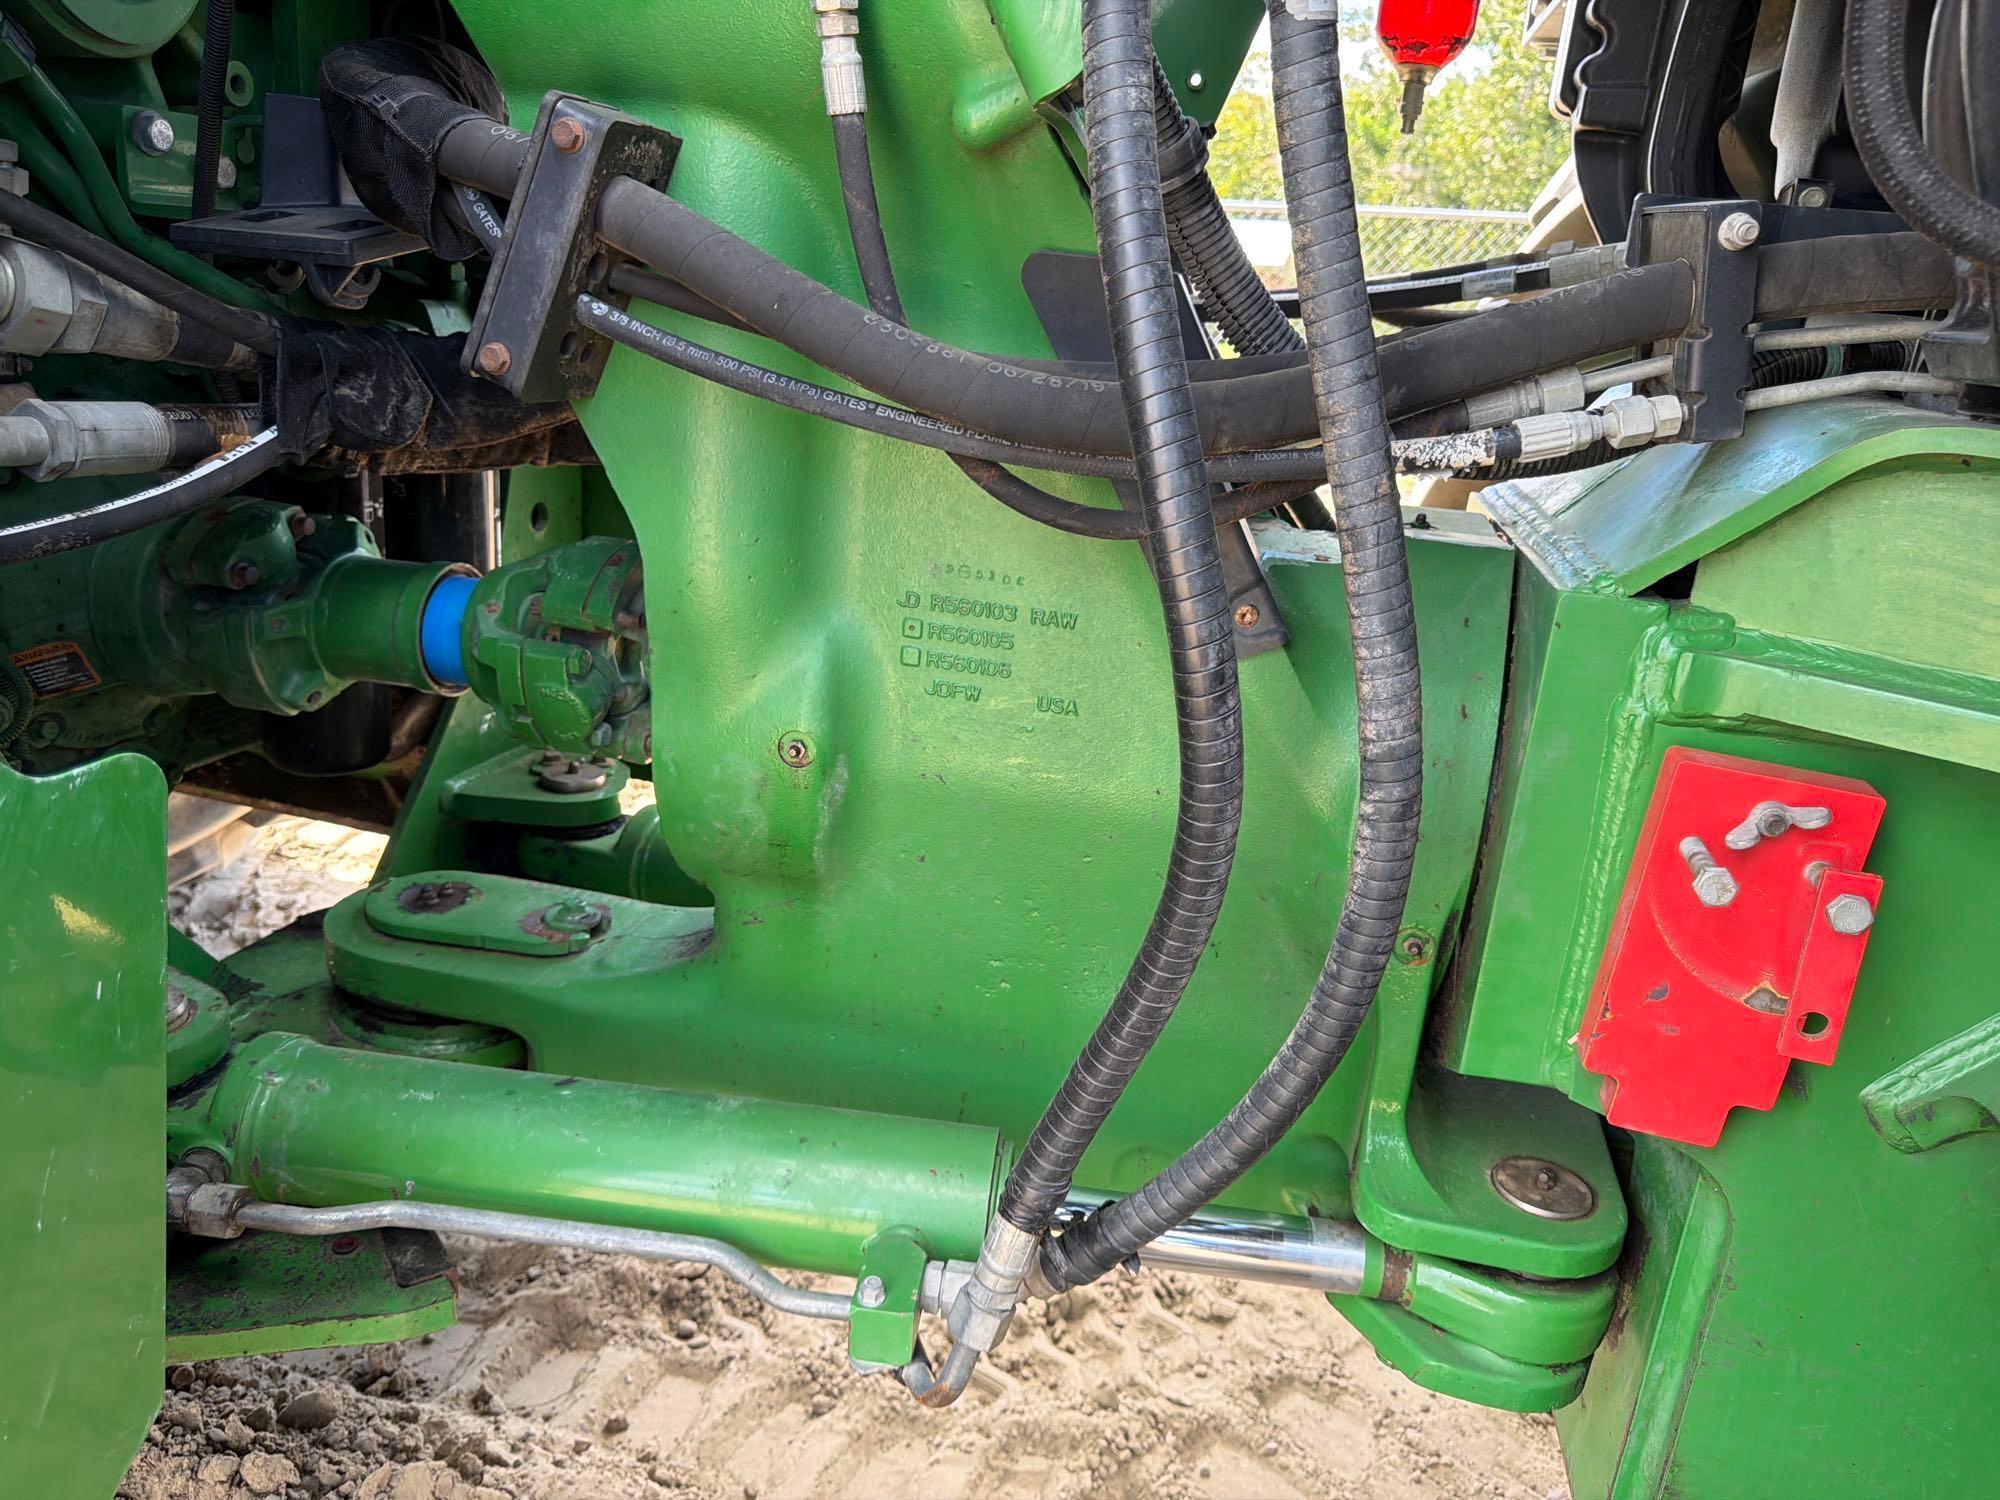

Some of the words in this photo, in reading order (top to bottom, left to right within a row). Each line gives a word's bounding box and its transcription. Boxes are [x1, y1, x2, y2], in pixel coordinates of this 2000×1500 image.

[609, 310, 630, 326] 3/8
[629, 320, 662, 341] INCH
[662, 335, 687, 351] (9.5
[686, 346, 715, 364] mm)
[716, 356, 740, 371] 500
[739, 364, 762, 380] PSI
[763, 372, 789, 388] (3.5
[788, 380, 821, 400] MPa)
[875, 405, 964, 435] ENGINEERED
[896, 591, 921, 608] JD
[930, 593, 1018, 622] R560103
[1030, 607, 1079, 630] RAW
[927, 621, 1015, 650] R560105
[926, 650, 1012, 679] R560106
[1036, 695, 1079, 717] USA
